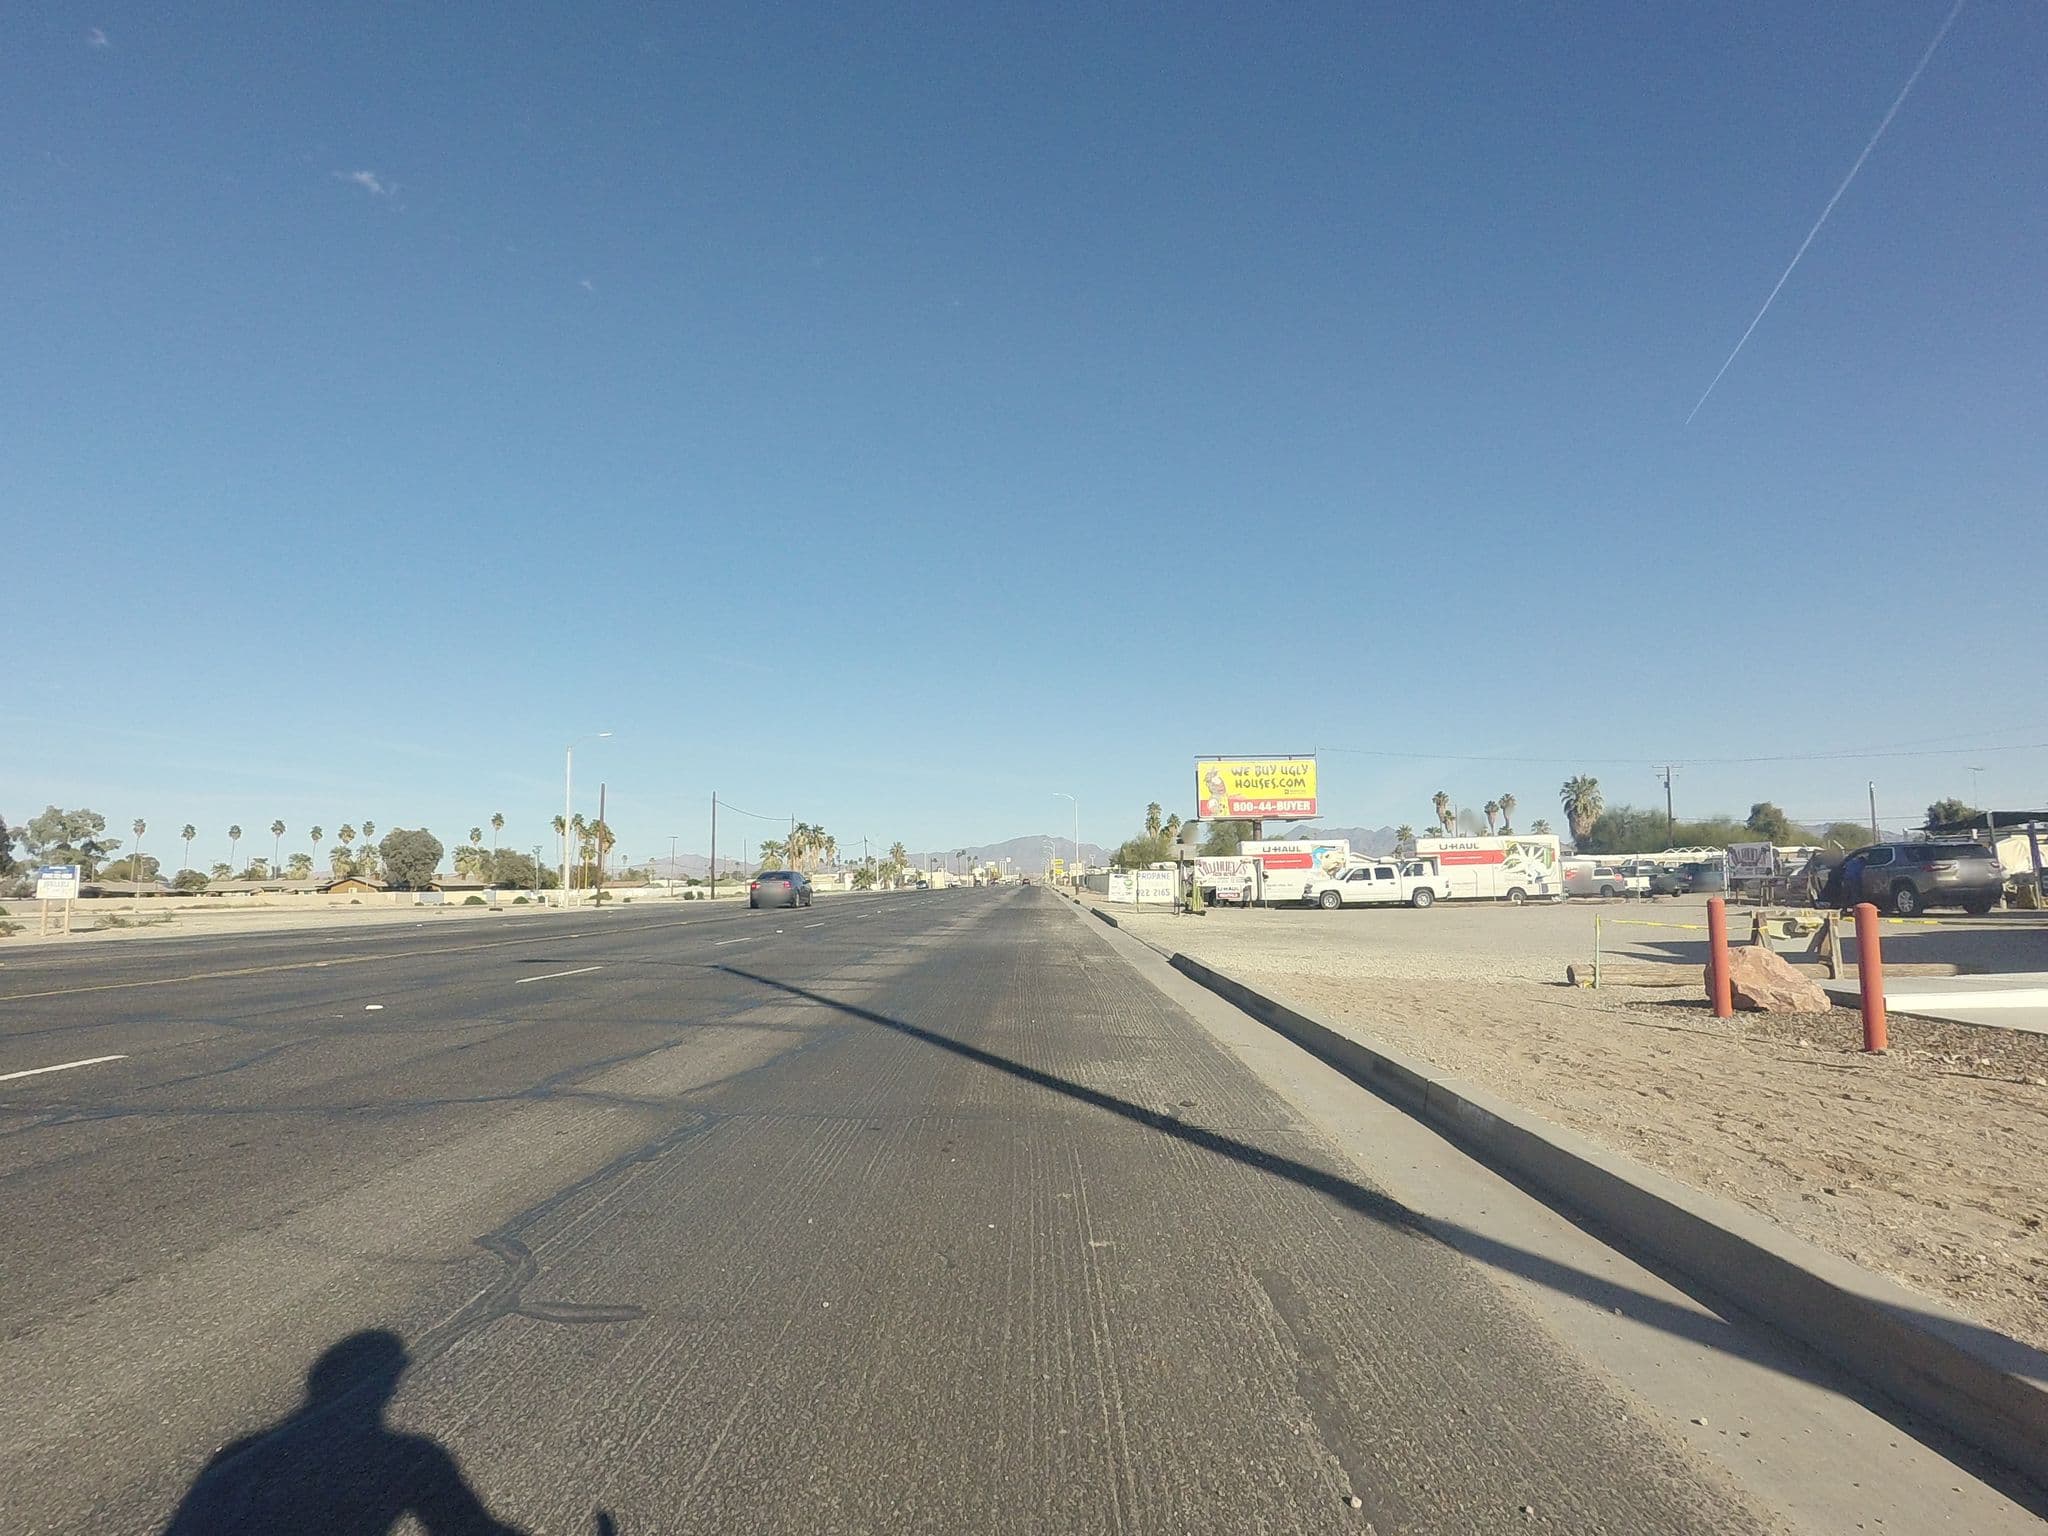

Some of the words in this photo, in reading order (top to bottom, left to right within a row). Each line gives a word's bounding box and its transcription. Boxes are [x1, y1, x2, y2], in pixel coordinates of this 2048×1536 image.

[1231, 766, 1250, 776] WE
[1255, 765, 1277, 777] BUY
[1281, 764, 1309, 776] UGLY
[1235, 778, 1306, 789] HOUSES.COM
[1233, 800, 1311, 812] 800-44-BUYER
